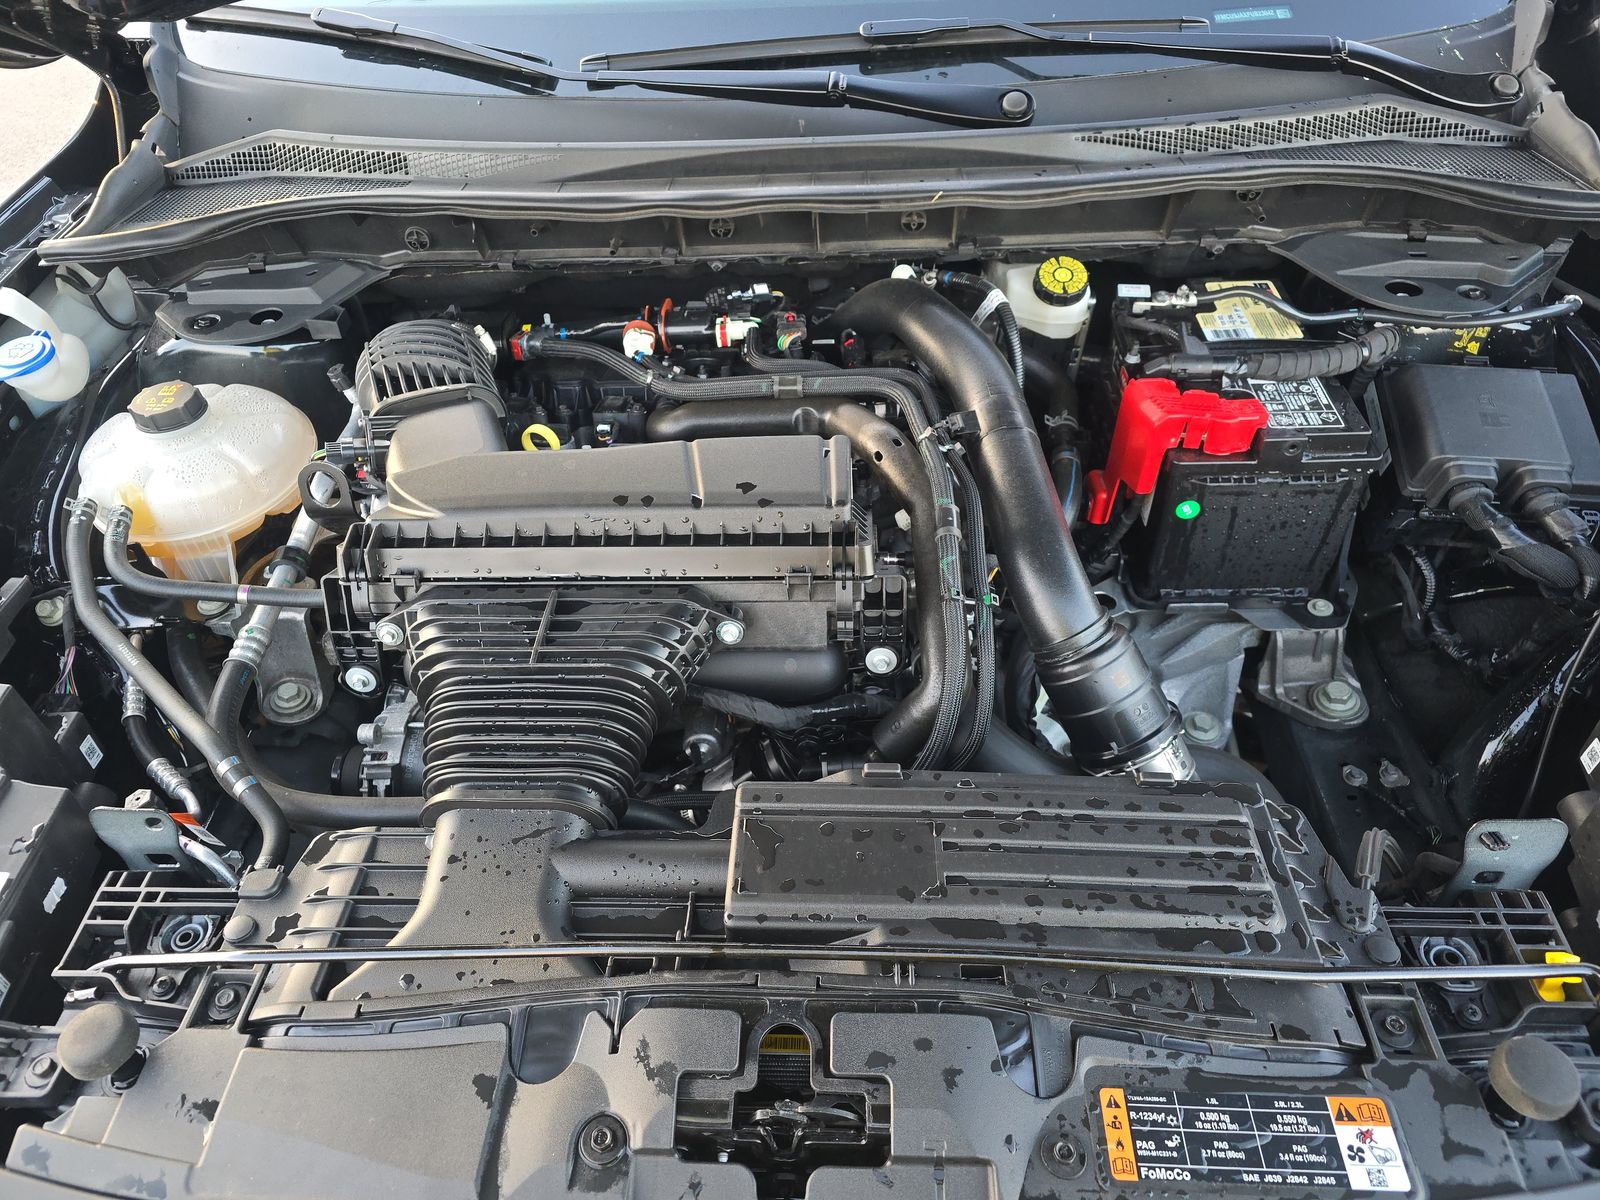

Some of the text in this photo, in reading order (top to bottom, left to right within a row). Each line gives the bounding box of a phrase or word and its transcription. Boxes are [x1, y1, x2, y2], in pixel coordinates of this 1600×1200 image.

[1130, 1111, 1166, 1121] R-1234yf
[1200, 1111, 1230, 1124] 0.500 kg
[1276, 1114, 1308, 1126] 0.550 kg
[1226, 1122, 1240, 1131] lbs)
[1291, 1124, 1307, 1133] (1.21
[1307, 1124, 1320, 1134] lbs)
[1136, 1140, 1156, 1150] PAG
[1213, 1141, 1229, 1149] PAG
[1292, 1145, 1308, 1153] PAG
[1278, 1152, 1289, 1161] 3.4
[1303, 1153, 1327, 1164] (100cc)
[1140, 1167, 1191, 1181] FoMoCo
[1242, 1173, 1261, 1182] SAE
[1263, 1174, 1283, 1183] J639
